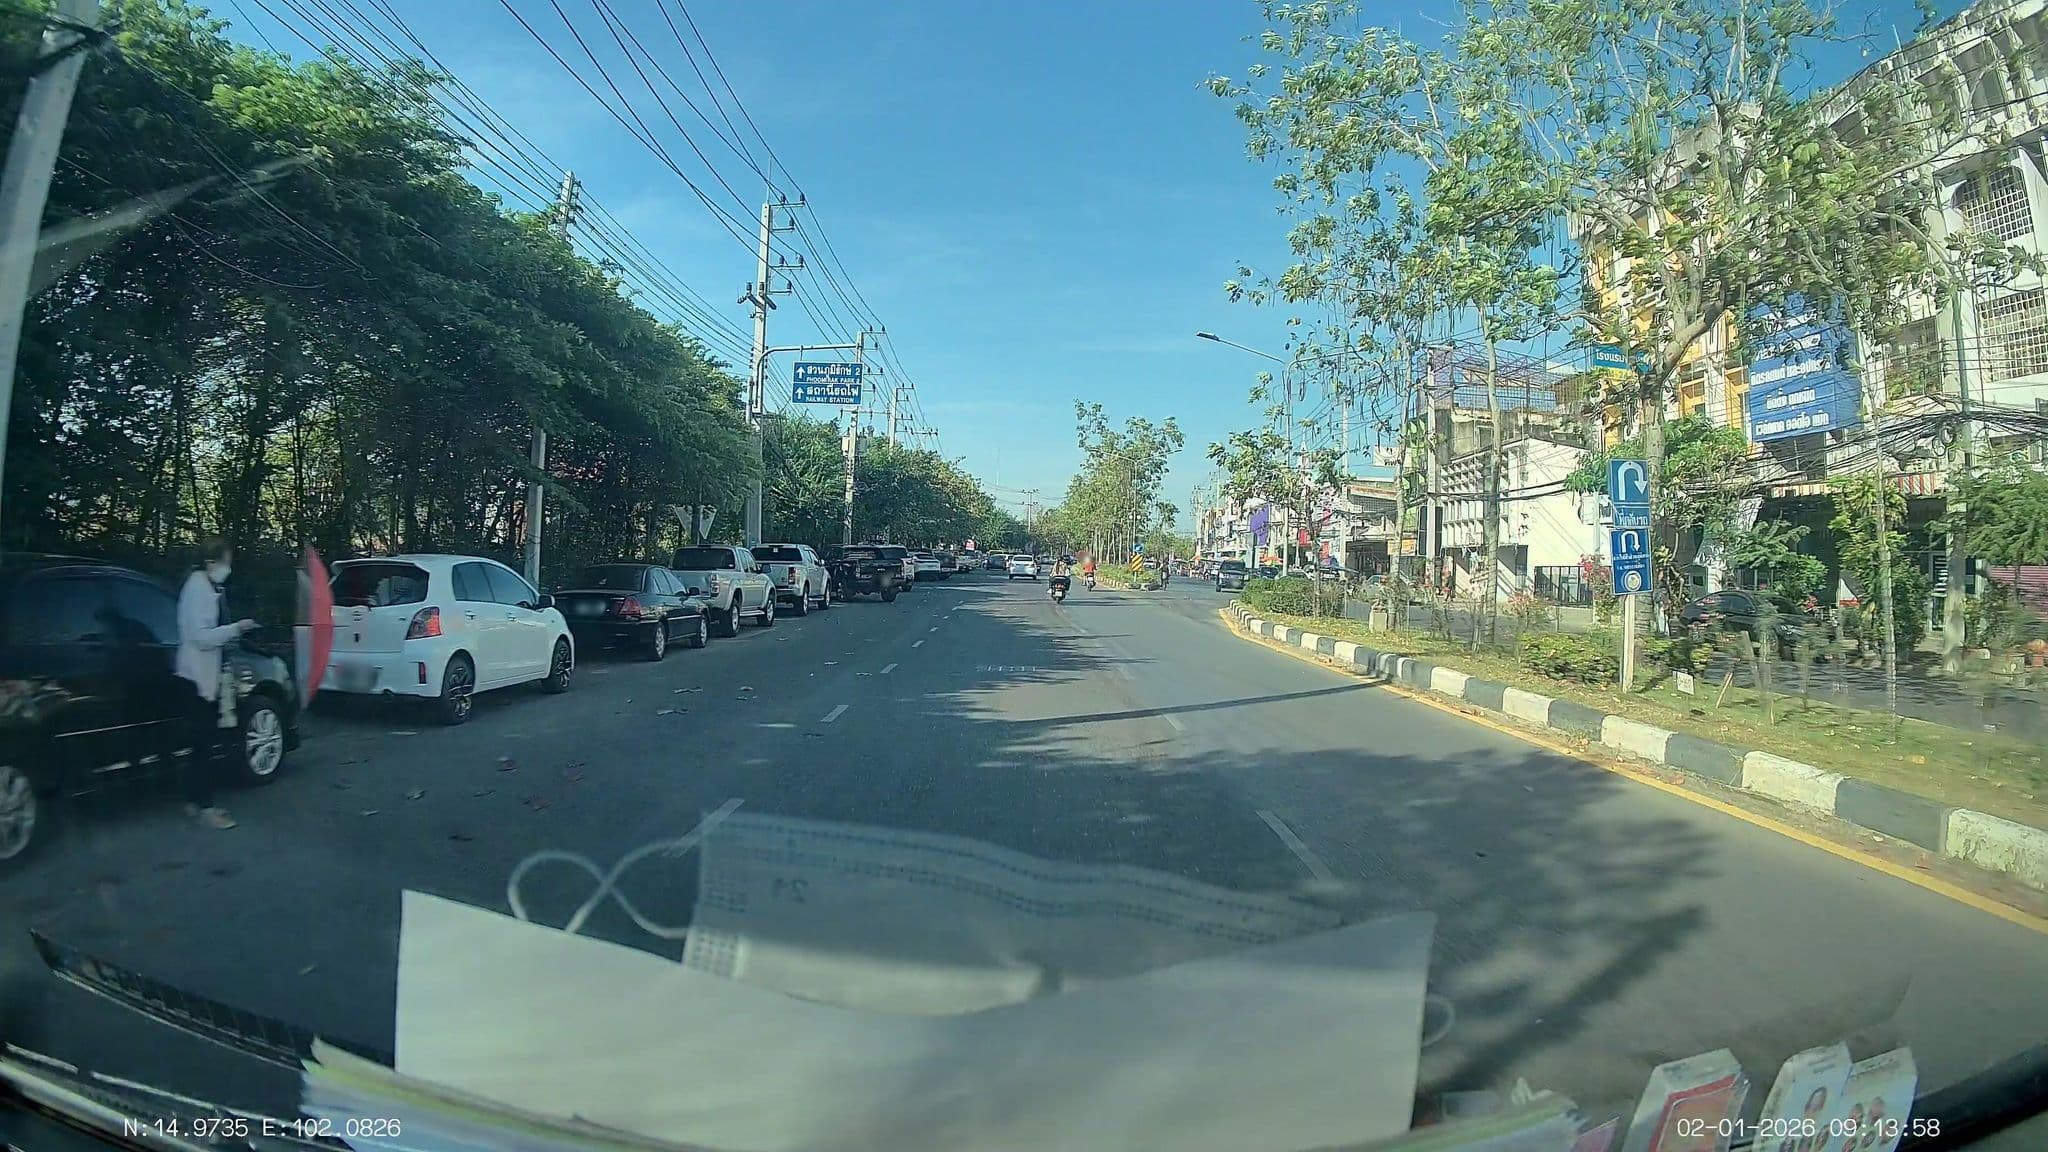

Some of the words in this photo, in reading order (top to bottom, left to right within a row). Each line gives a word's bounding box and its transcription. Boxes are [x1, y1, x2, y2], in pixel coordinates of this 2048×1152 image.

[855, 367, 861, 376] 2
[806, 384, 858, 397] สถานีรถไฟ
